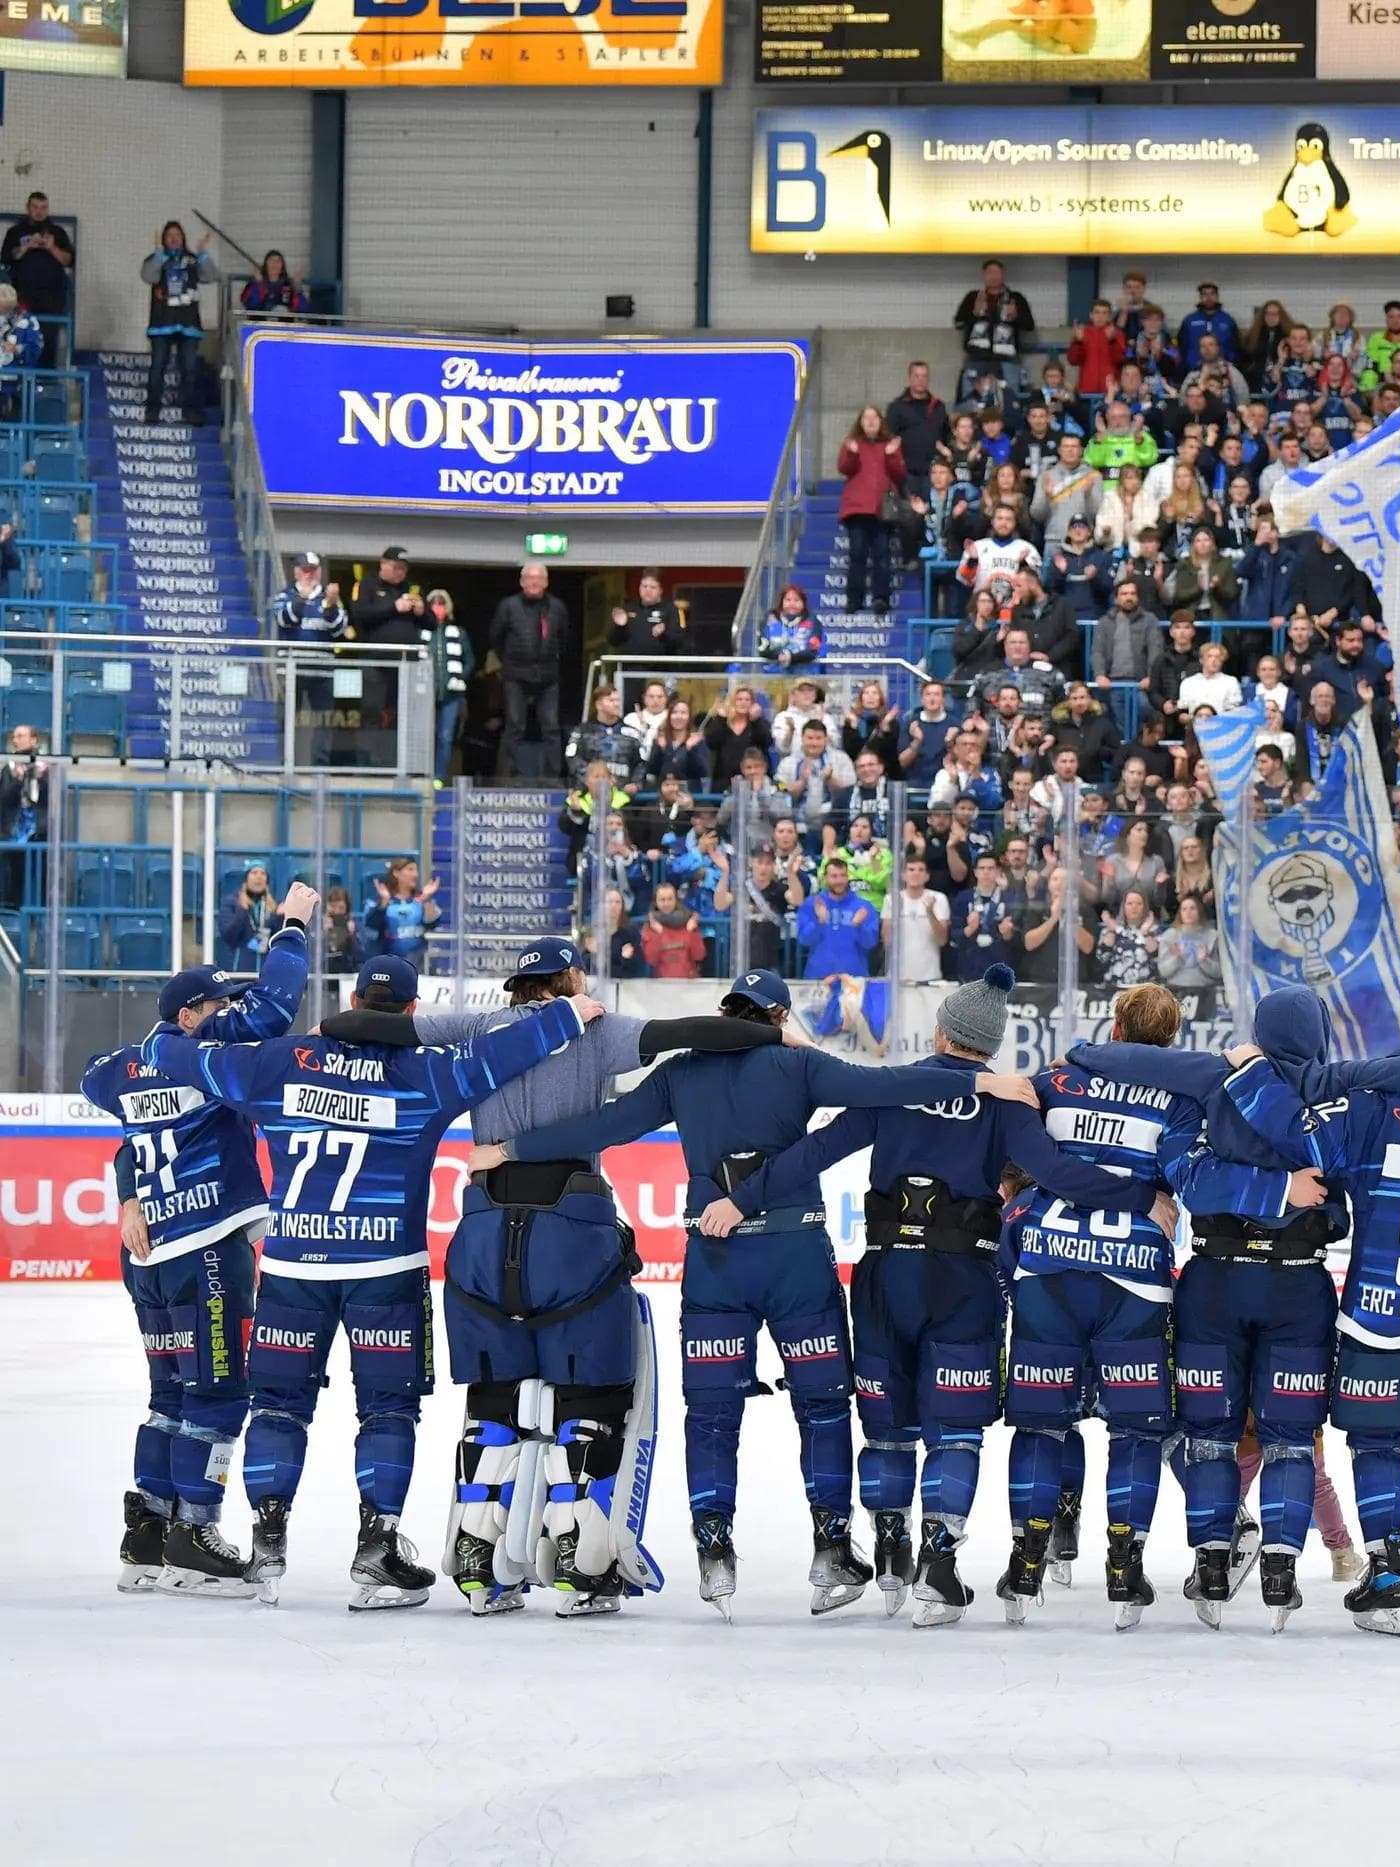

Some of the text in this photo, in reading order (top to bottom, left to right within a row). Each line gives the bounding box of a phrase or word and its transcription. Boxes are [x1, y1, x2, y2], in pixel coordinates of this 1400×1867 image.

[8, 1, 103, 25] EME
[1186, 20, 1281, 41] elements
[234, 46, 494, 63] ARBEITSBÜHNEN
[556, 47, 689, 62] STAPLER
[923, 138, 1260, 165] Linux/Open Source Consulting,
[441, 355, 624, 394] Privatbrauerei
[338, 390, 717, 465] NORDBRÄU
[438, 469, 624, 496] INGOLSTADT
[323, 1052, 385, 1082] SATURN
[130, 1090, 181, 1120] SIMPSON
[296, 1087, 370, 1123] BOURQUE
[1087, 1076, 1173, 1111] SATURN
[1073, 1112, 1126, 1146] HÜTTL
[131, 1128, 180, 1199] 21
[283, 1130, 370, 1212] 77
[140, 1180, 221, 1226] OLSTADT
[281, 1213, 399, 1242] INGOLSTADT
[1046, 1234, 1160, 1272] INGOLSTADT
[1360, 1286, 1394, 1316] ERC
[256, 1325, 316, 1349] CINQUE
[351, 1327, 412, 1348] CINQUE
[686, 1336, 746, 1358] CINQUE
[936, 1367, 993, 1388] CINQUE
[1013, 1363, 1075, 1386] CINQUE
[1273, 1371, 1327, 1394] CINQUE
[1339, 1376, 1399, 1398] CINQUE
[624, 1437, 653, 1535] VAUGHN
